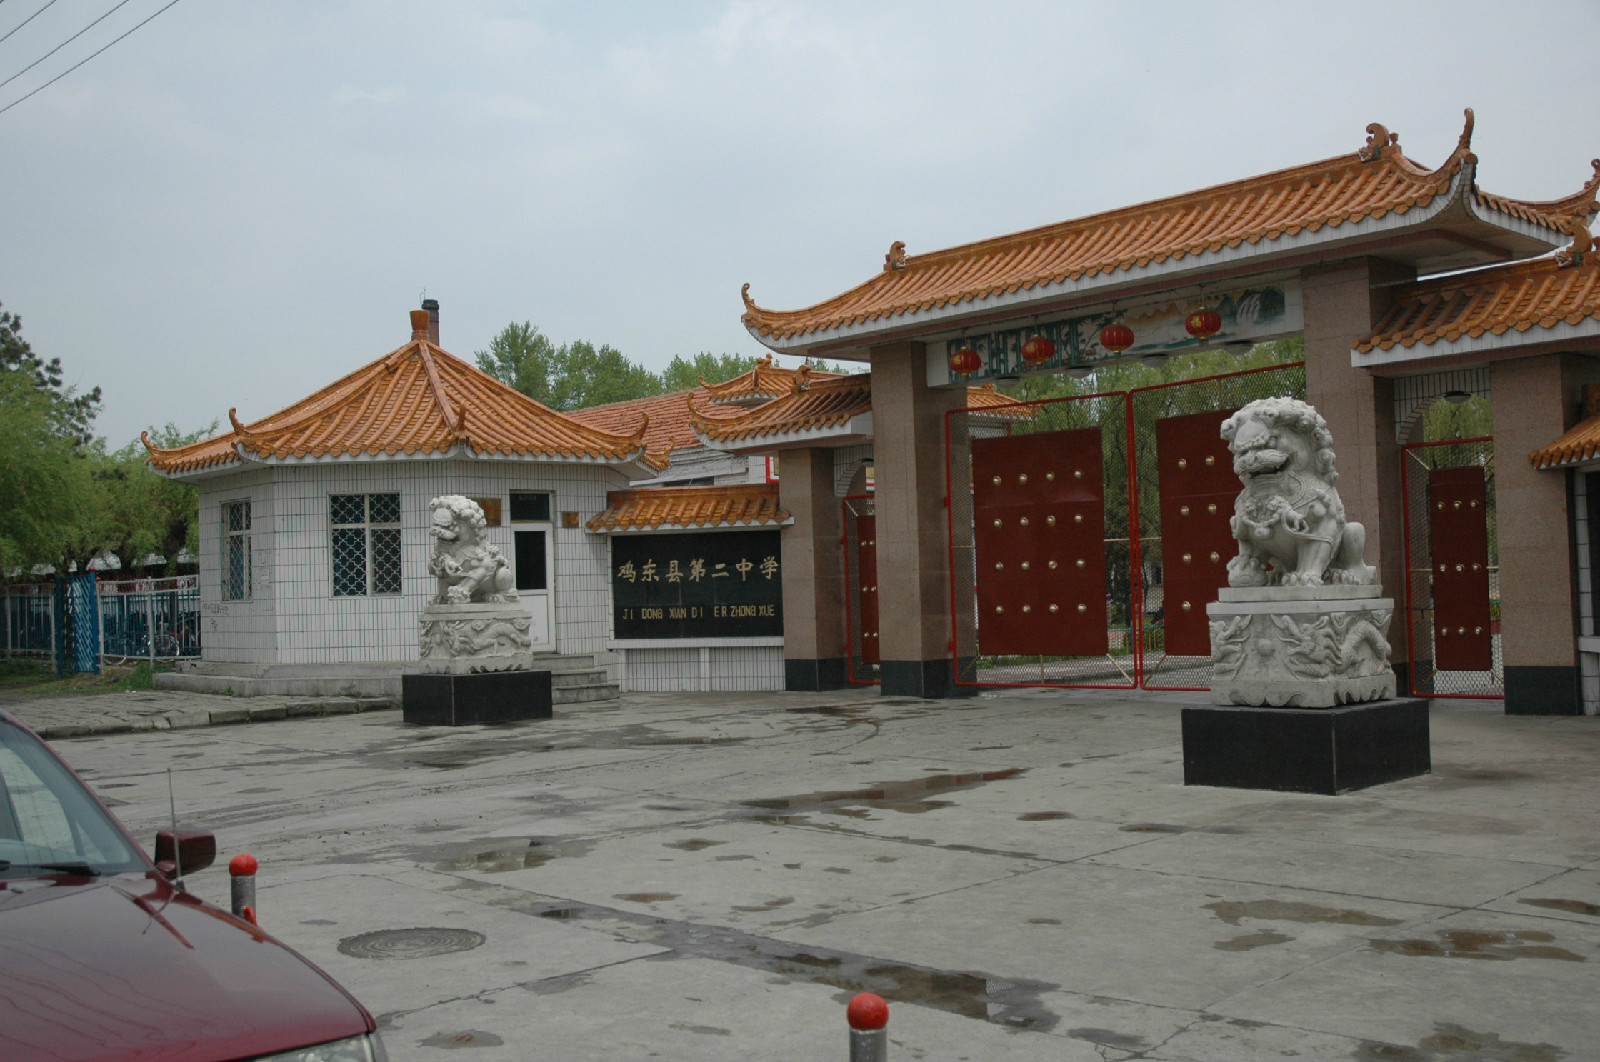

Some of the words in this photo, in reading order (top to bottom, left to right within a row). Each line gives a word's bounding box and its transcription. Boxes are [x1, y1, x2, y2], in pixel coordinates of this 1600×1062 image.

[617, 556, 779, 583] 鸡东县第二中学
[622, 608, 633, 620] JI
[641, 608, 663, 620] DONG
[669, 607, 687, 619] XIAN
[691, 606, 703, 618] DI
[714, 605, 727, 617] ER
[730, 605, 757, 617] ZHONG
[758, 604, 775, 617] XUE
